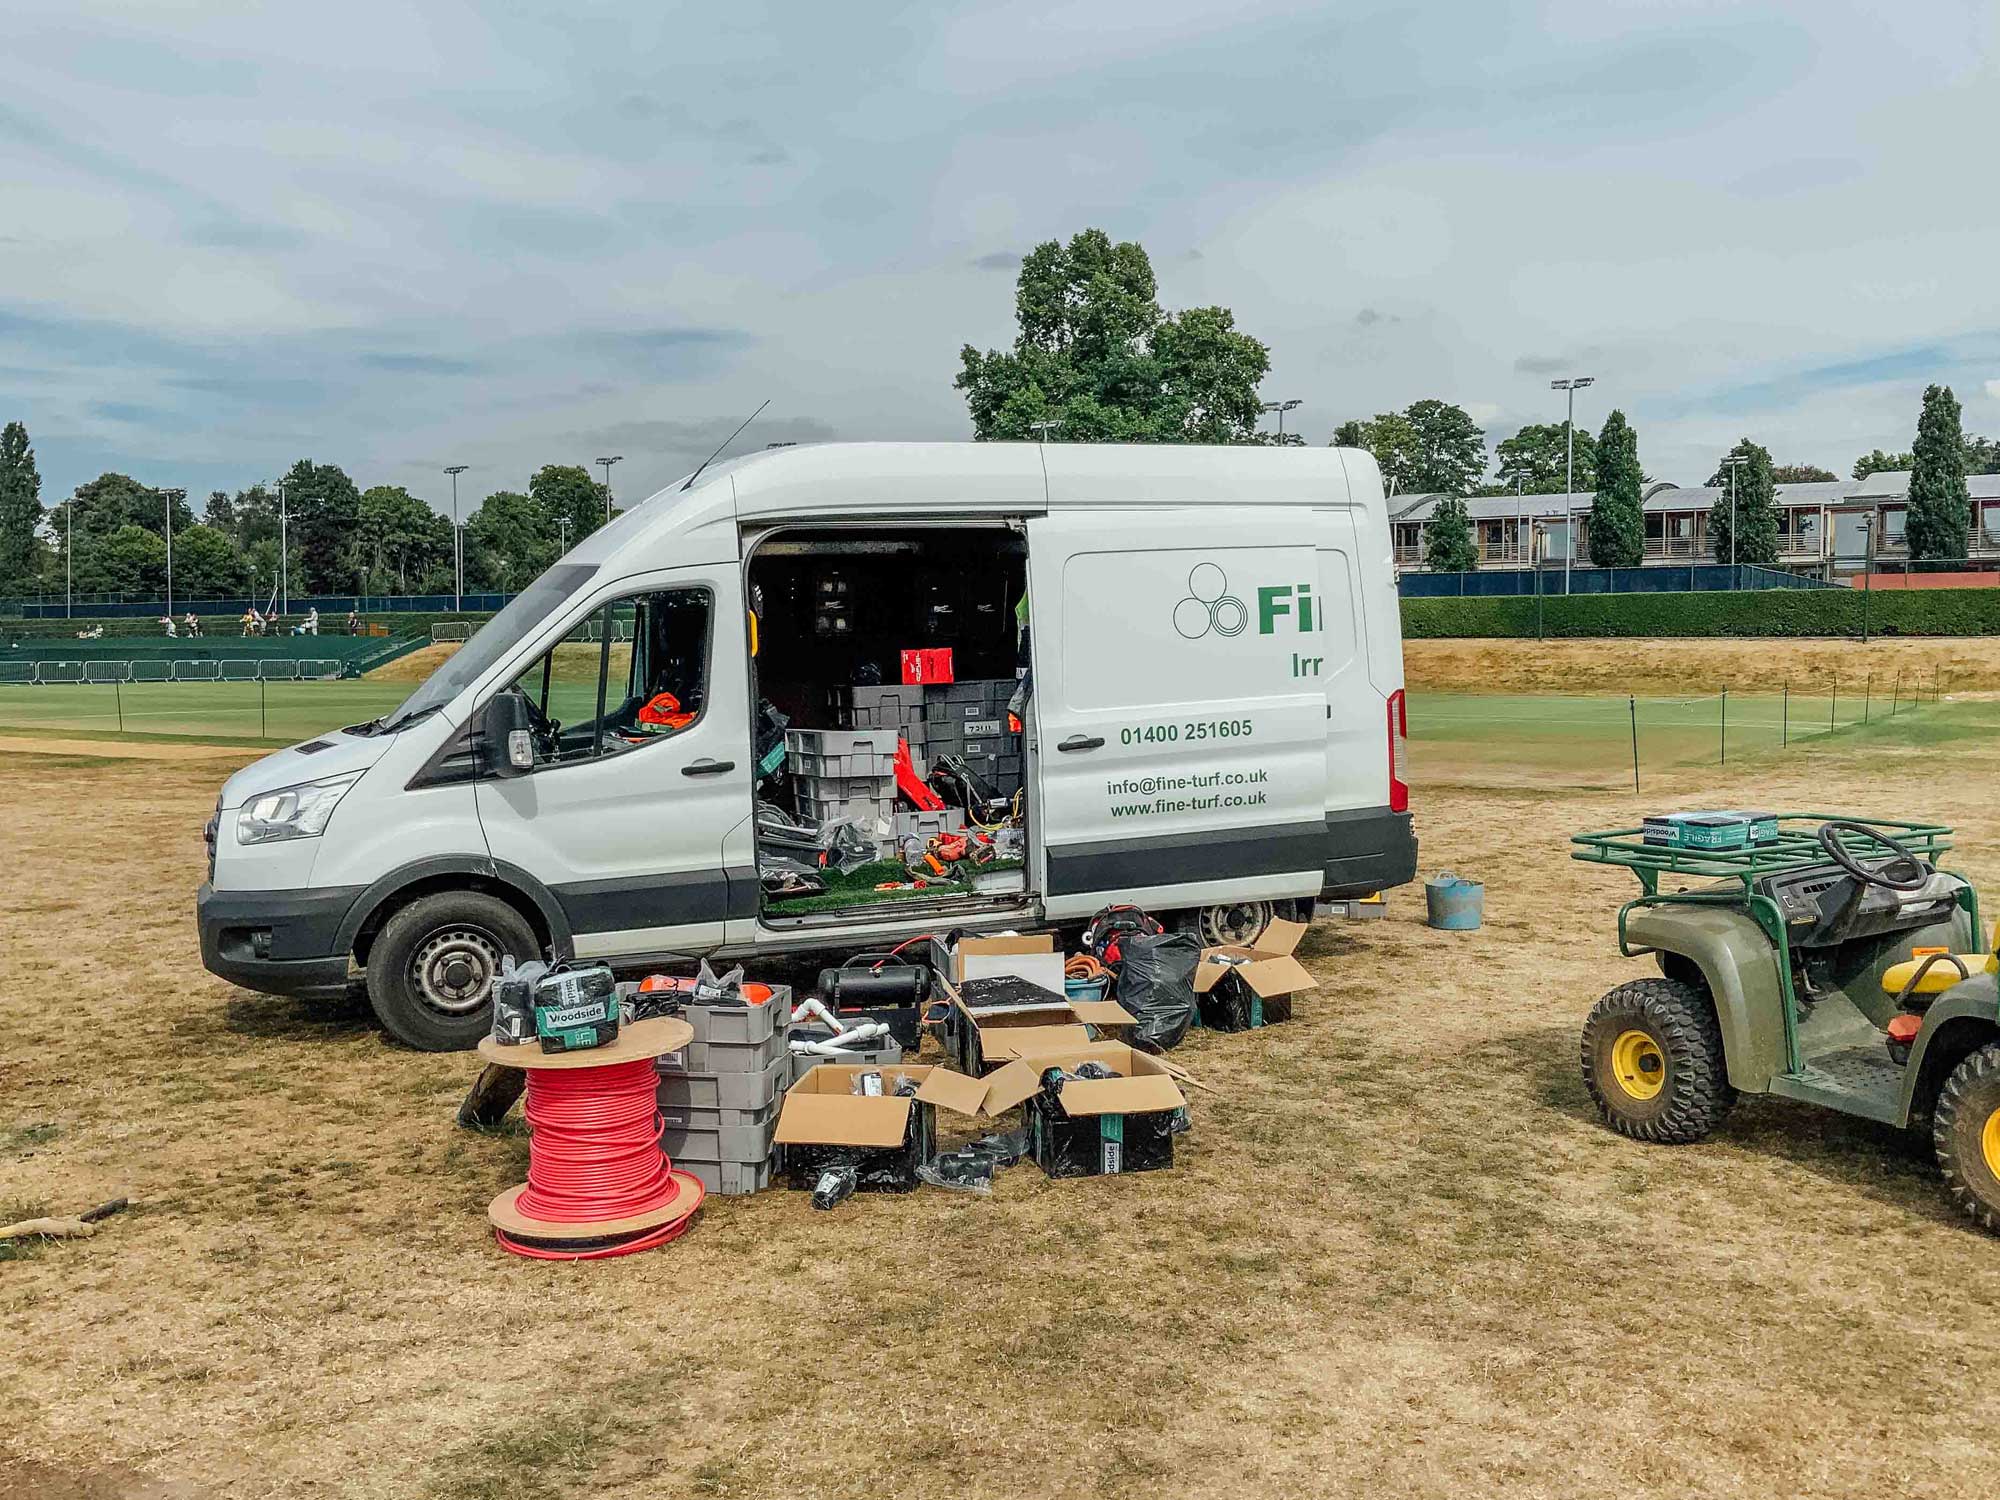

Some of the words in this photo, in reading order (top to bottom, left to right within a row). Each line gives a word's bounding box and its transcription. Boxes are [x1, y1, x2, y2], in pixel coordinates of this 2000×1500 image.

[1258, 584, 1323, 634] Fi
[1120, 725, 1178, 745] 01400
[1185, 720, 1252, 740] 251605
[1107, 769, 1268, 795] info@fine-turf.co.uk
[1111, 791, 1267, 817] www.fine-turf.co.uk
[549, 1007, 602, 1023] Woodside
